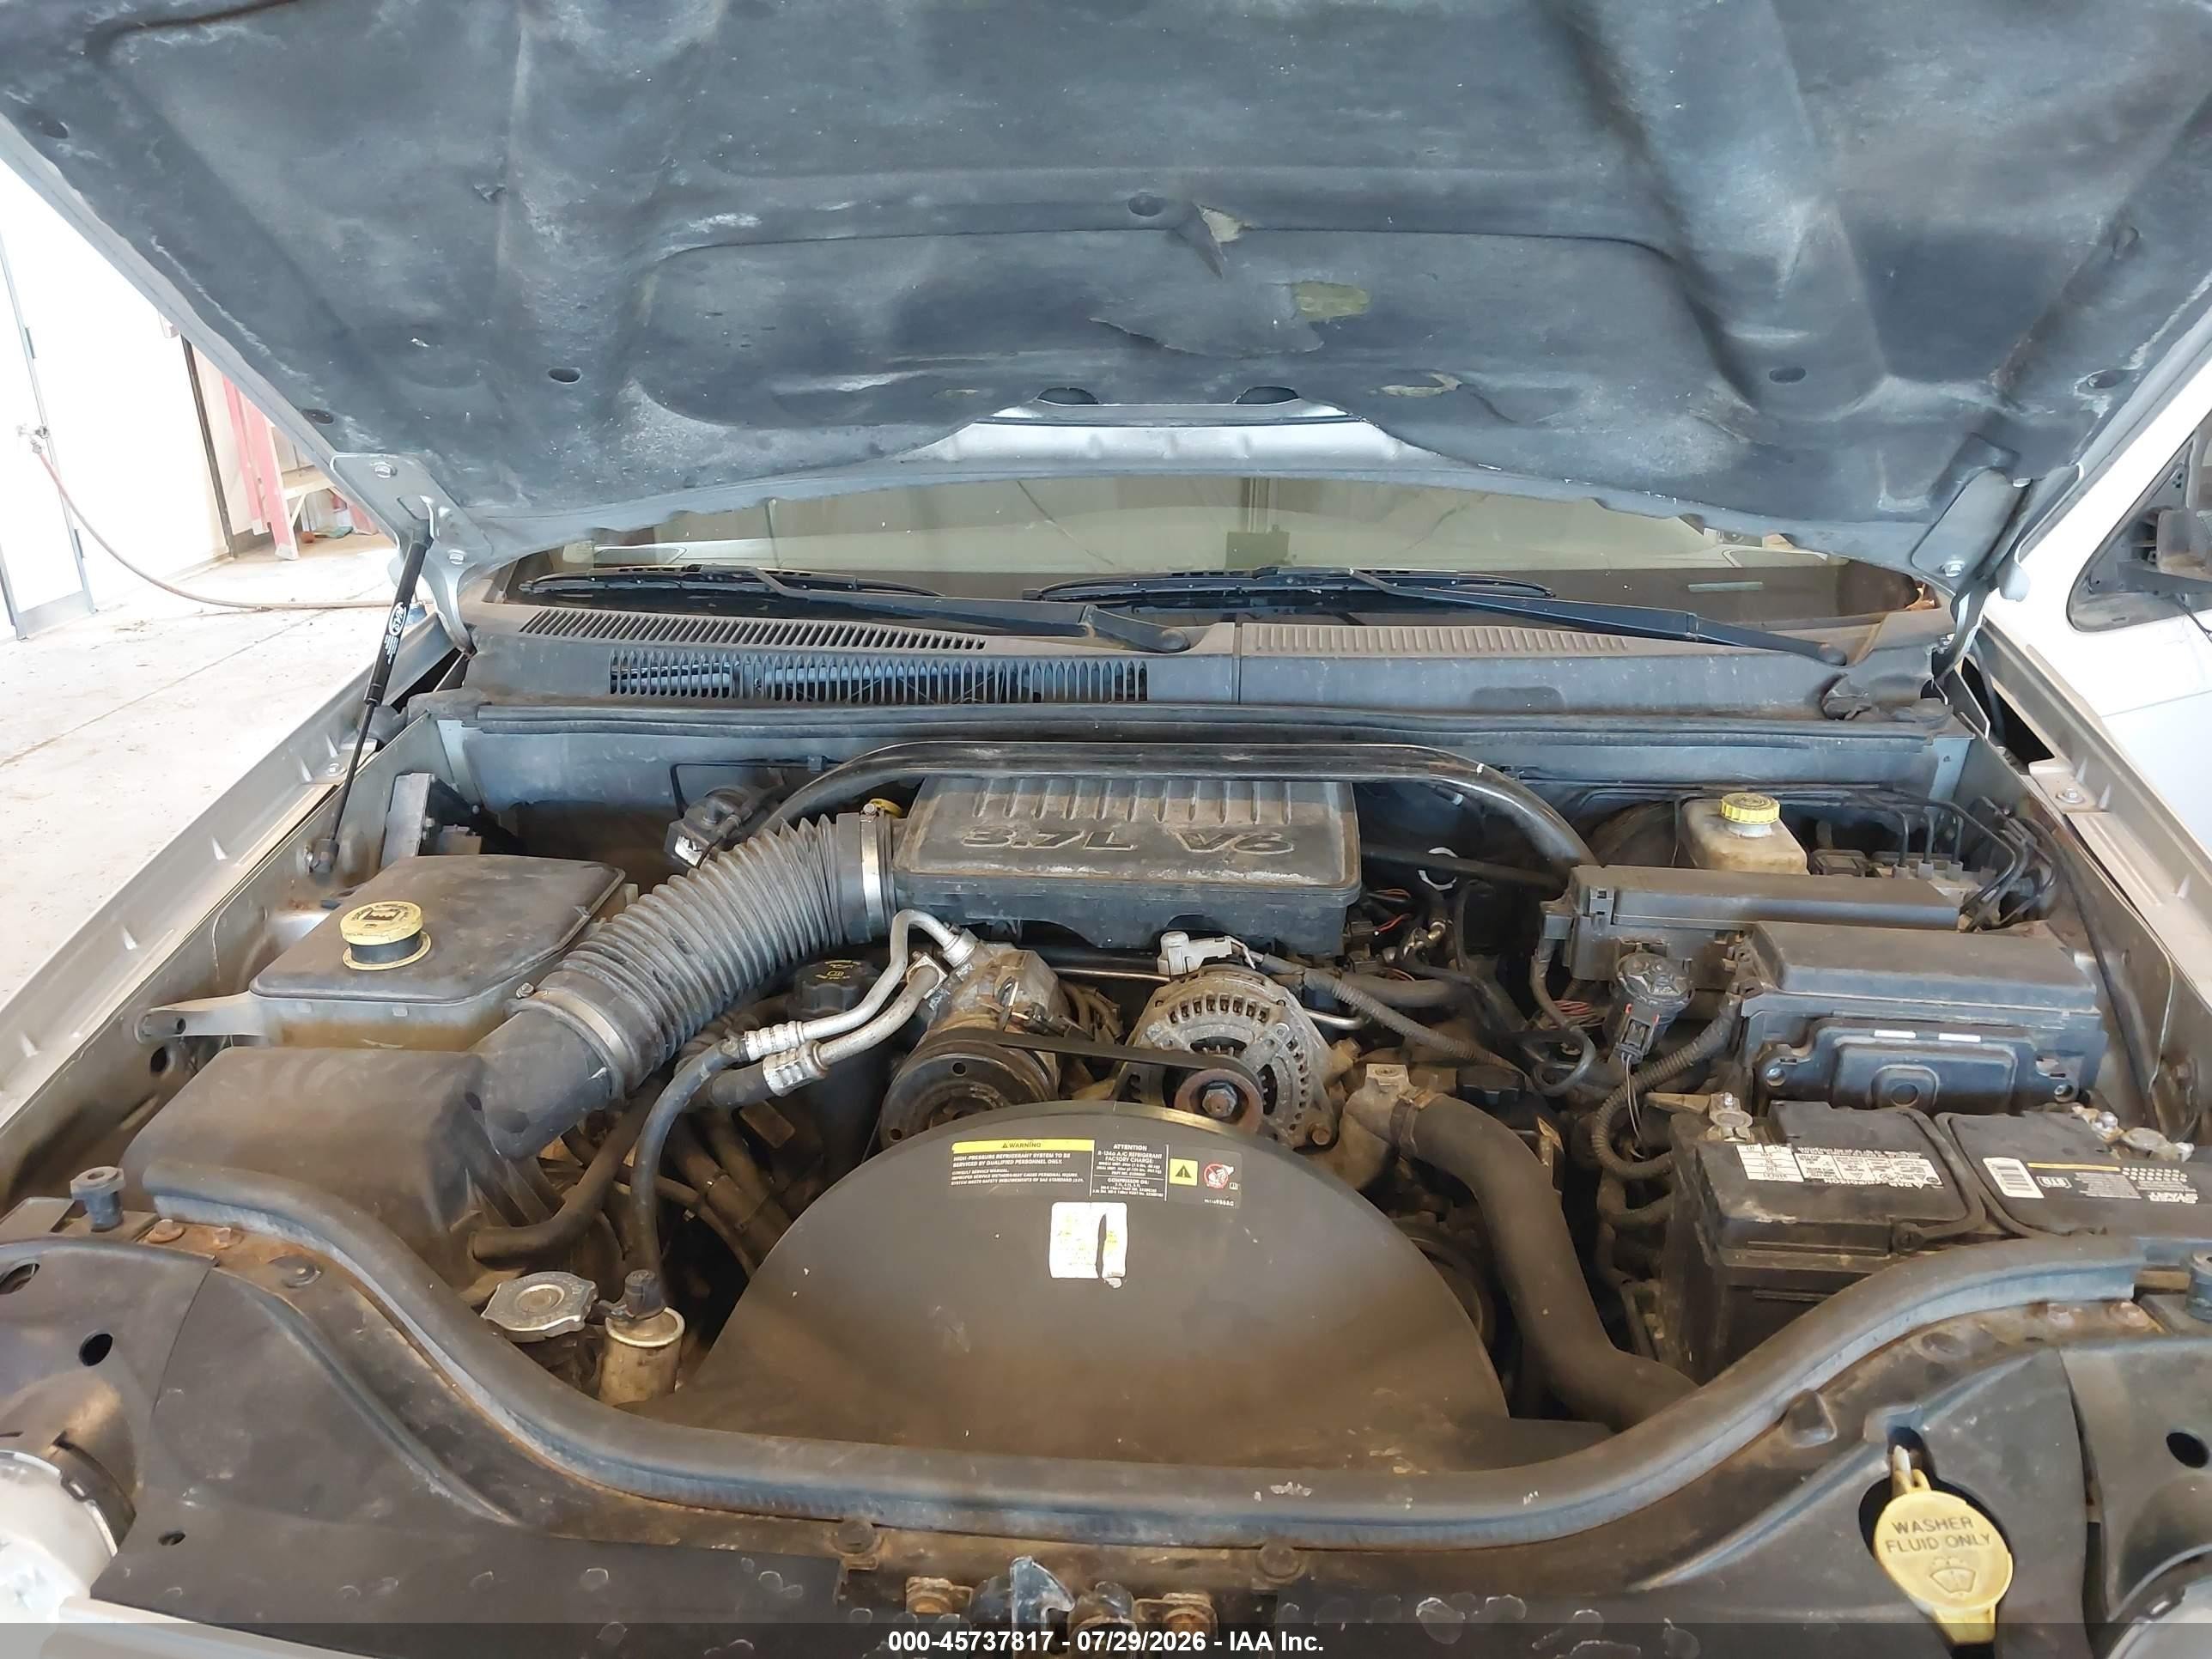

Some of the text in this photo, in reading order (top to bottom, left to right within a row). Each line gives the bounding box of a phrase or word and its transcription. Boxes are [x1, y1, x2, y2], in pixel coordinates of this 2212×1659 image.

[961, 823, 1295, 856] 3.7L V6
[1891, 1516, 1974, 1534] WASHER
[1885, 1533, 1990, 1553] FLUID ONLY
